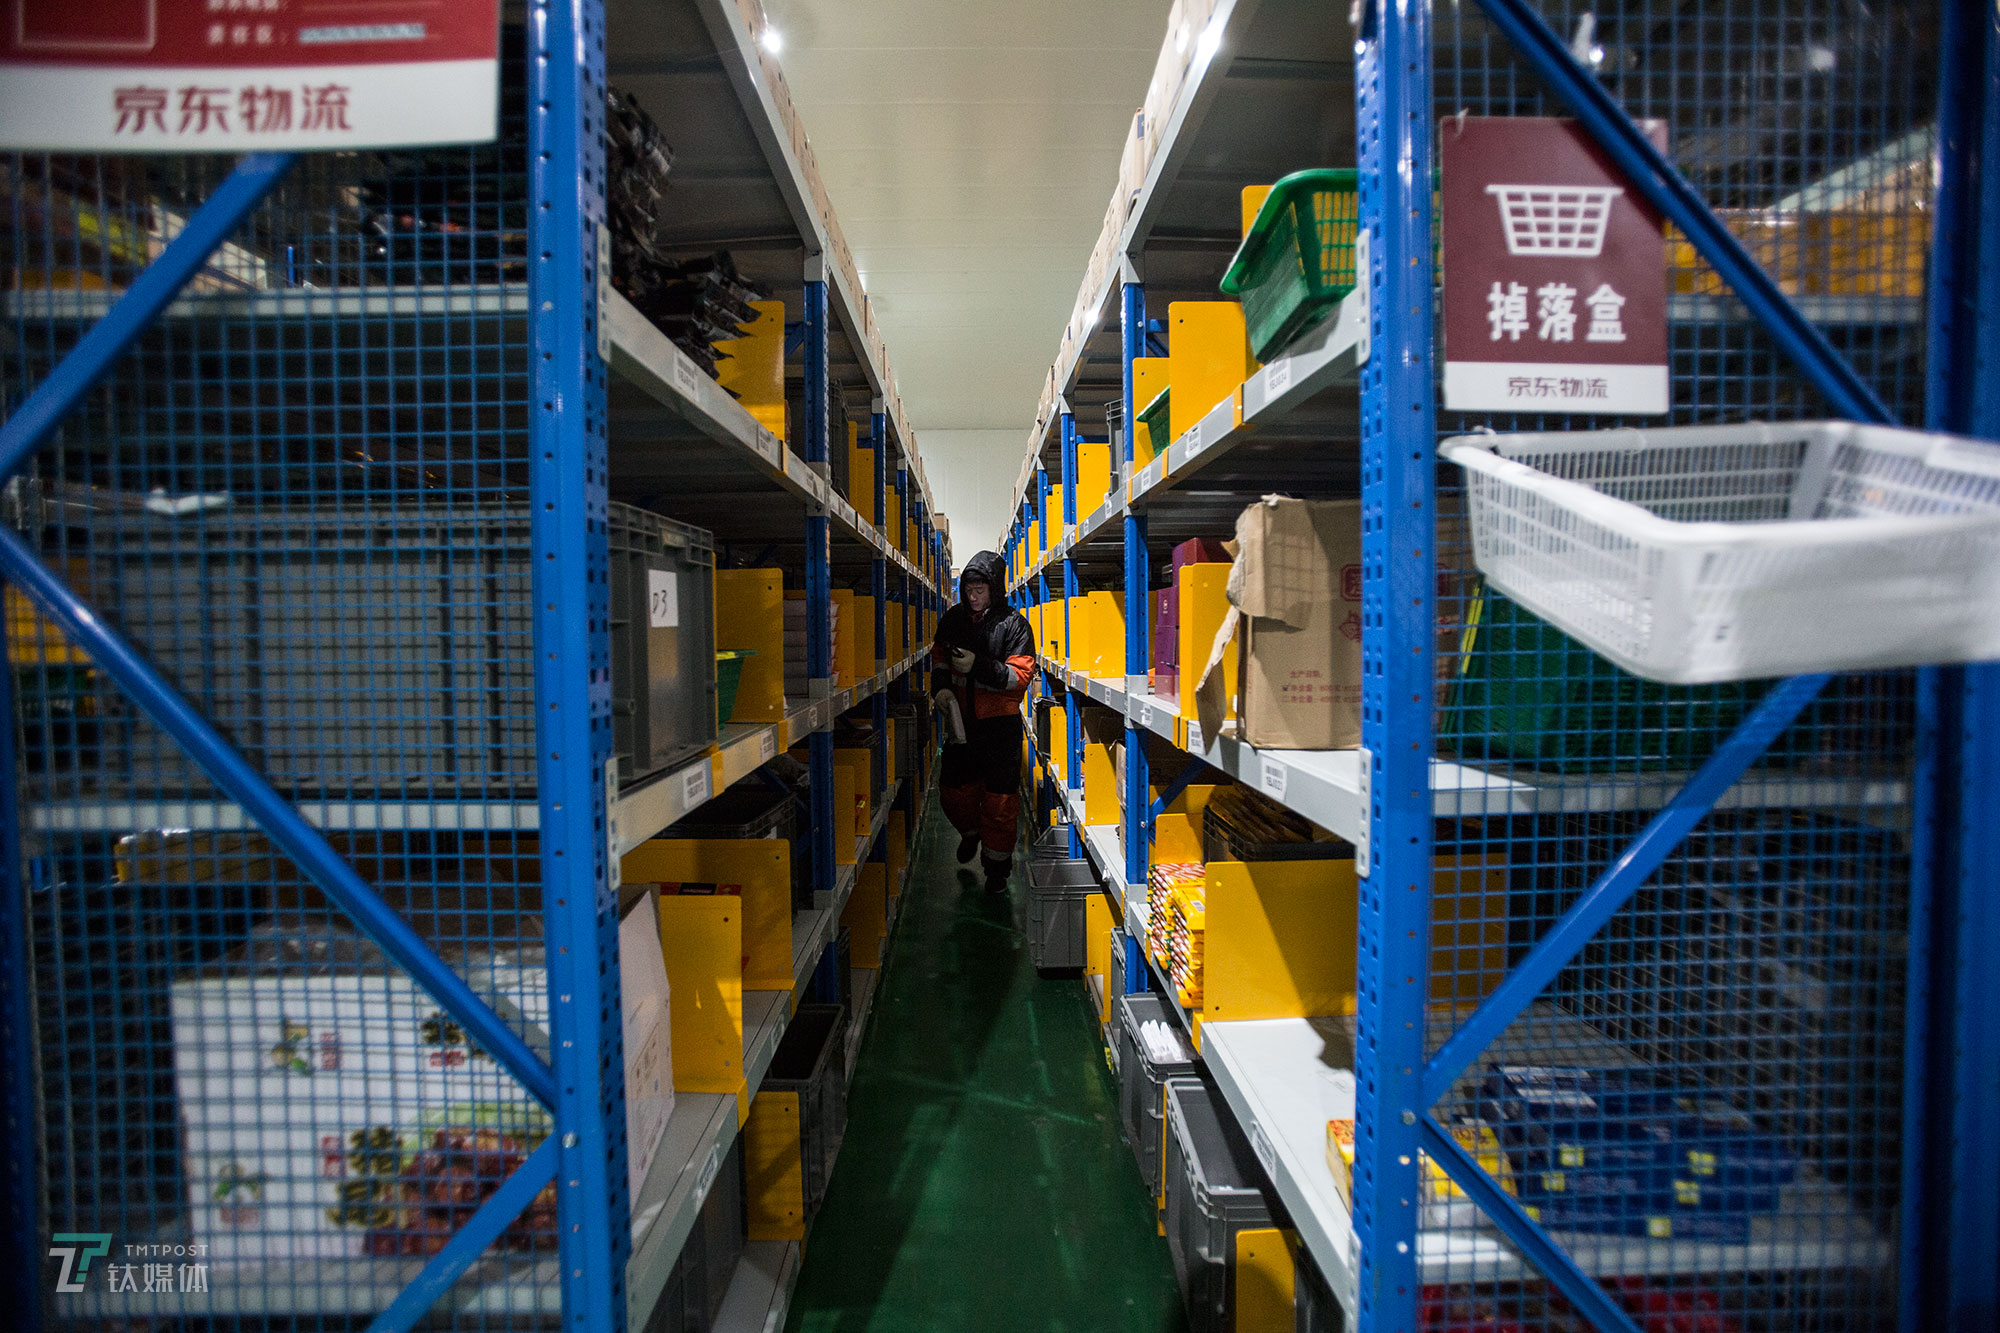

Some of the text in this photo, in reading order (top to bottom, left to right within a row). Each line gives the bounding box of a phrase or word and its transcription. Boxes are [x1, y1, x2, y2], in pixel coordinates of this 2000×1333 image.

[114, 85, 351, 134] 京东物流
[1487, 281, 1627, 342] 掉落盒
[1507, 376, 1609, 399] 京东物流
